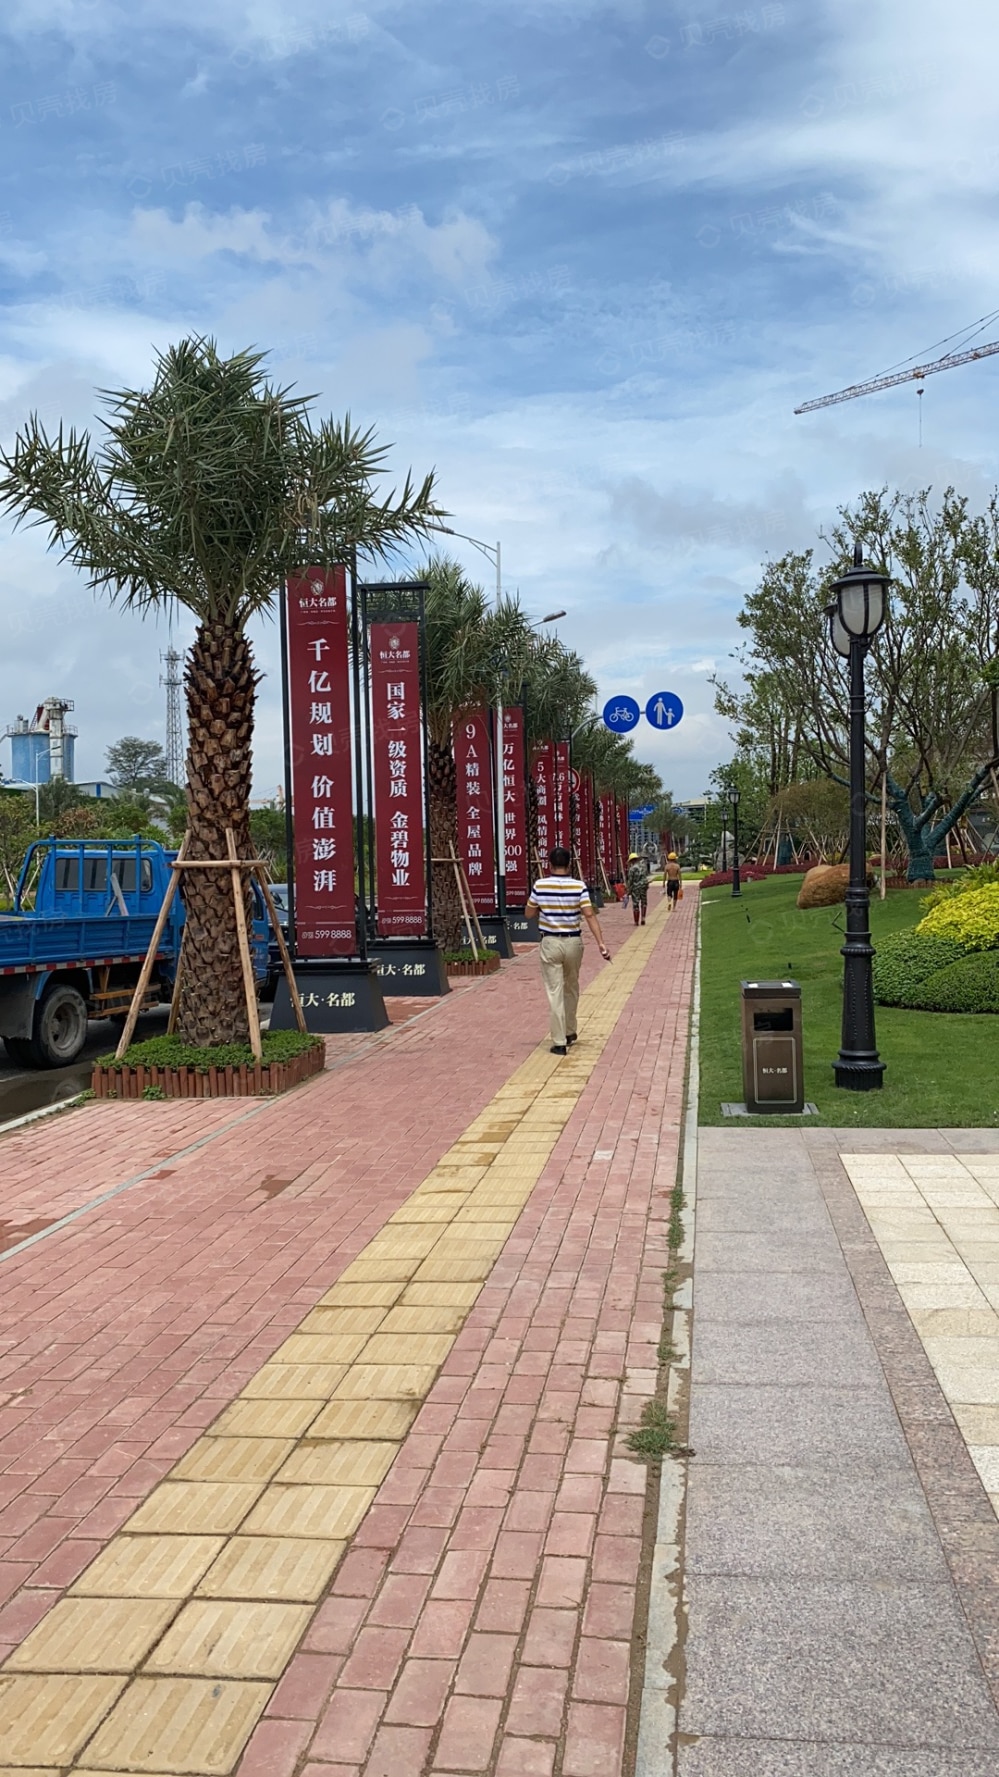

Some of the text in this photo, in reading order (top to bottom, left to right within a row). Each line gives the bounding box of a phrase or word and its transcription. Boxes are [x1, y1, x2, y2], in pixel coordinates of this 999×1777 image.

[299, 597, 337, 608] 恒大名都
[380, 650, 411, 659] 恒大名都
[307, 638, 332, 756] 千亿规划
[386, 682, 408, 798] 国家一级资质
[465, 723, 480, 796] 9A精装
[503, 742, 516, 803] 万亿恒大
[311, 775, 336, 892] 价值澎湃
[390, 811, 411, 887] 金碧物业
[466, 806, 483, 876] 全屋品牌
[314, 930, 330, 939] 599
[330, 929, 352, 939] 8888
